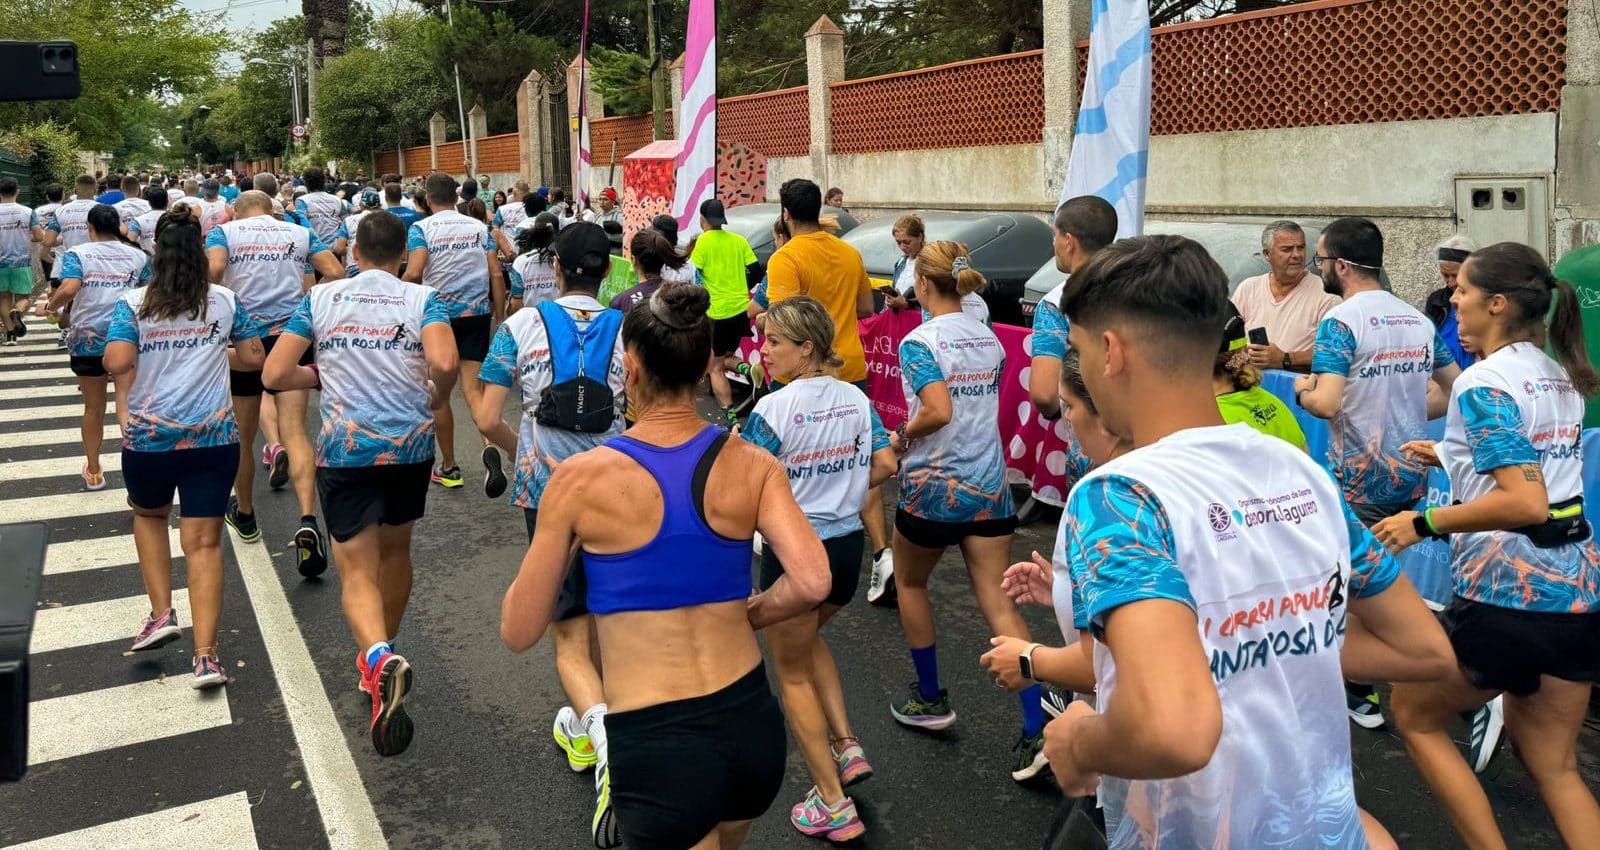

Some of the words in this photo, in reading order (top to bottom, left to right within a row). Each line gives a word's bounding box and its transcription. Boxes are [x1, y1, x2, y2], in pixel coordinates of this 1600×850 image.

[452, 242, 469, 250] ROSA
[229, 253, 255, 265] SANTA
[258, 253, 280, 262] ROSA
[282, 253, 293, 261] DE
[172, 337, 198, 348] ROSA
[202, 337, 214, 346] DE
[352, 338, 381, 351] ROSA
[385, 340, 399, 350] DE
[961, 384, 984, 397] ROSA
[987, 383, 998, 395] DE
[576, 384, 585, 414] EVADICT
[817, 459, 845, 476] ROSA
[1210, 637, 1269, 682] ANTA
